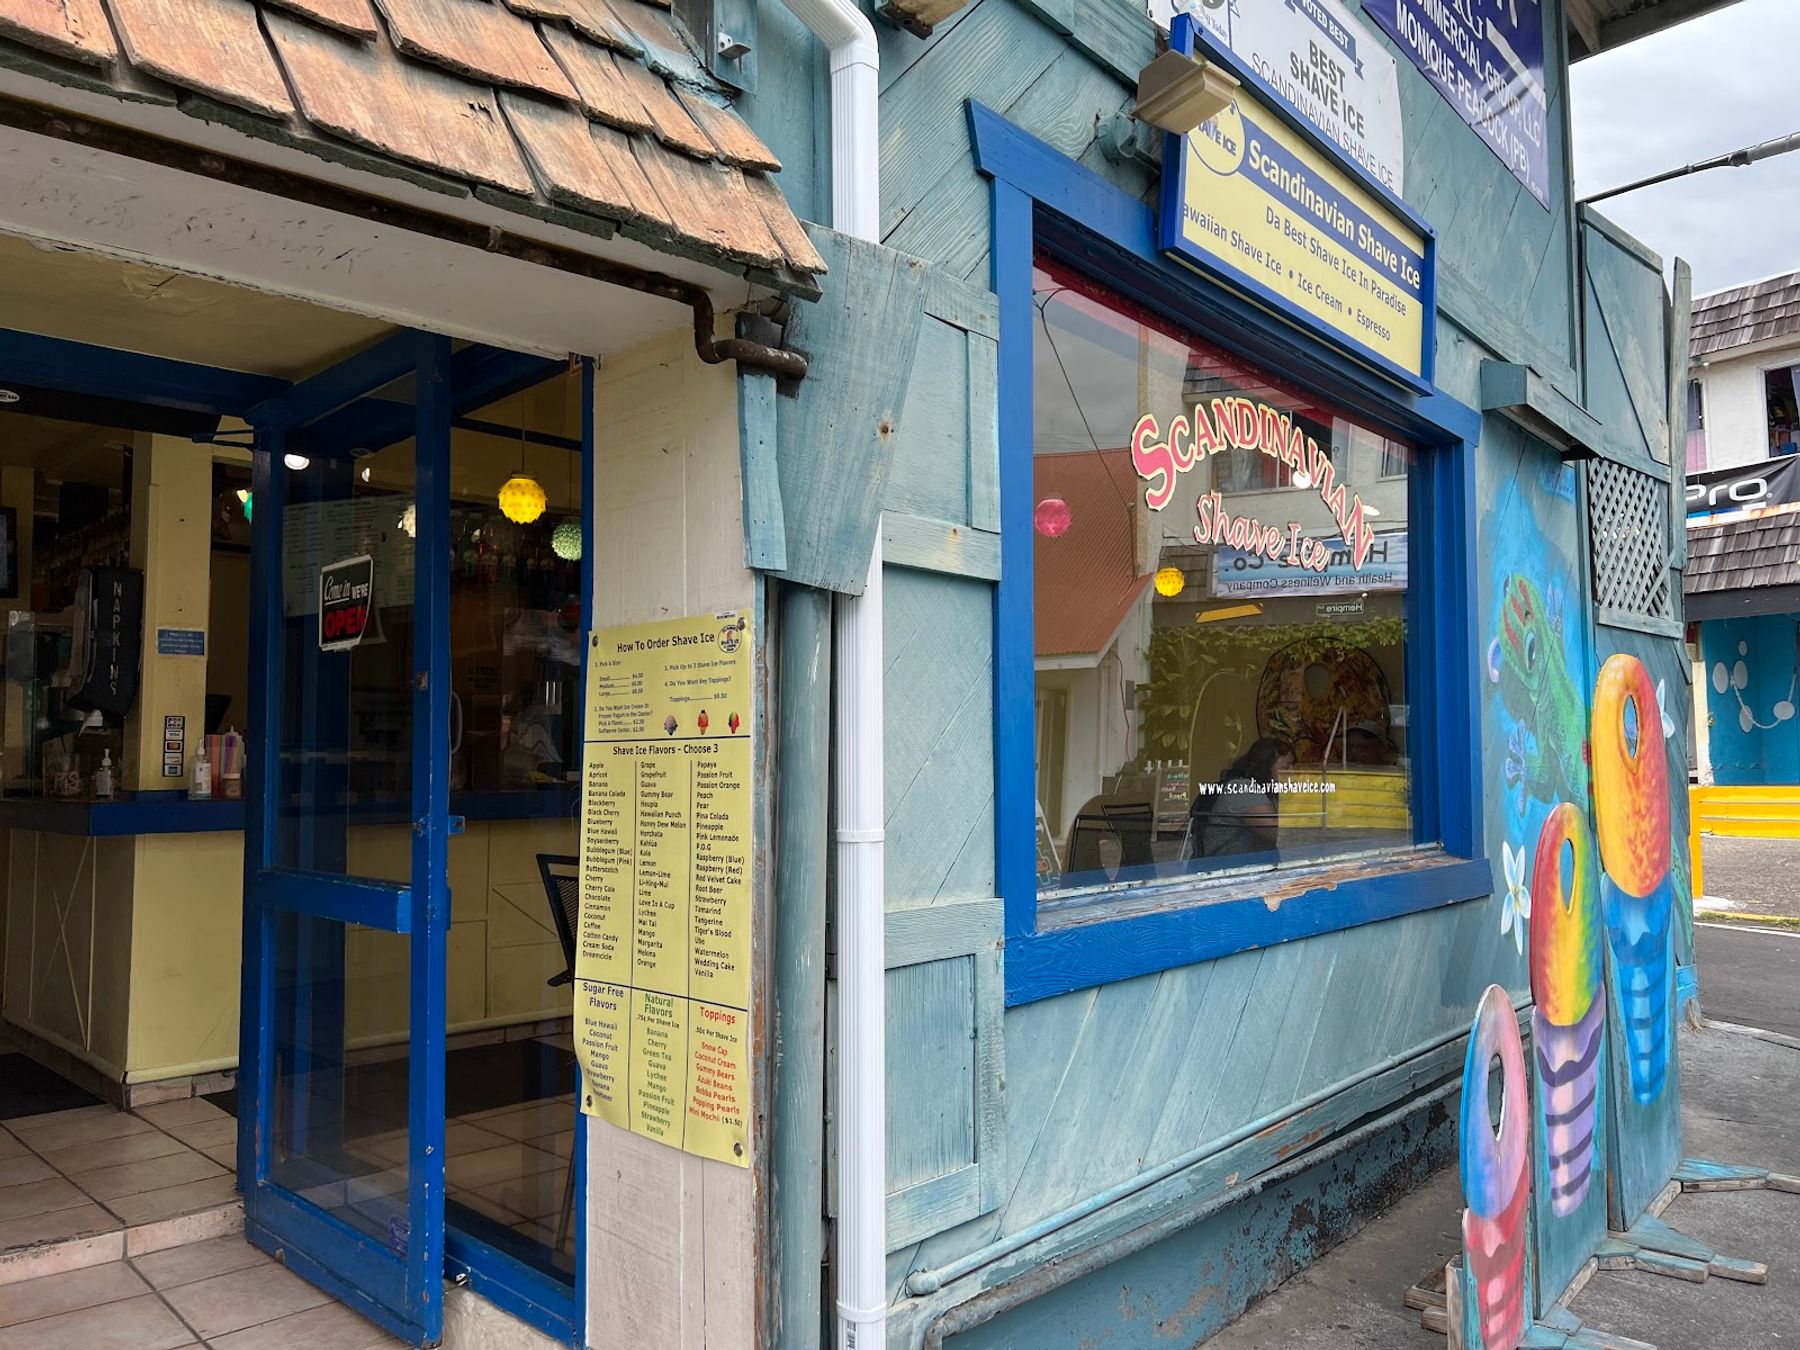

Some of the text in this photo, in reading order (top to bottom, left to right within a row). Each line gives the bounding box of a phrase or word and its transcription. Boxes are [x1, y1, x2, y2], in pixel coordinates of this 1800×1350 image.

[1301, 0, 1349, 49] VOTED BEST
[1309, 40, 1346, 92] BEST
[1417, 0, 1485, 81] MMERCIAL
[1522, 106, 1540, 147] LLC
[1290, 52, 1365, 138] SHAVE ICE
[1396, 1, 1455, 92] MONIQUE
[1457, 69, 1509, 154] PEACOCK
[1510, 135, 1530, 182] (PB)
[1252, 53, 1394, 191] SCANDINAVIAN SHAVE ICE
[1199, 120, 1236, 156] AVE ICE
[1248, 139, 1420, 290] Scandinavian Shave Ice
[1184, 204, 1282, 275] awaiian Shave Ice
[1266, 206, 1406, 316] Da Best Shave Ice In Paradise
[1298, 272, 1342, 312] Ice Cream
[1357, 308, 1390, 340] Espresso
[1131, 396, 1374, 571] SCANDINAVIAN
[1193, 490, 1286, 560] Shave
[1288, 522, 1330, 572] Ice
[324, 576, 369, 600] Come in WE'RE
[324, 605, 367, 639] OPEN
[110, 580, 123, 697] NAPKINS
[617, 643, 633, 653] How
[635, 641, 644, 651] To
[646, 638, 669, 650] Order
[672, 634, 698, 646] Shave
[700, 633, 714, 643] Ice
[613, 746, 633, 756] Shave
[636, 746, 646, 755] Ice
[649, 745, 676, 755] Flavors
[684, 744, 711, 754] Choose
[714, 744, 718, 752] 3
[1199, 778, 1336, 795] www.scandinavianshaveice.com
[587, 847, 615, 855] Bubblegum
[586, 856, 615, 864] Bubblegum
[696, 854, 744, 864] Raspberry (Blue)
[639, 870, 670, 878] Lemon-Lime
[696, 864, 742, 875] Raspberry (Red)
[696, 885, 708, 893] Root
[696, 895, 726, 905] Strawberry
[584, 903, 611, 911] Cinnamon
[695, 906, 721, 914] Tamarind
[695, 916, 723, 925] Tangerine
[602, 934, 618, 942] Candy
[638, 929, 655, 937] Mango
[695, 927, 732, 937] Tiger's Blood
[638, 939, 663, 948] Margarita
[695, 948, 729, 959] Watermelon
[637, 959, 656, 968] Orange
[695, 958, 734, 970] Wedding Cake
[695, 969, 713, 978] Vanilla
[583, 983, 624, 997] Sugar Free
[590, 997, 617, 1010] Flavors
[645, 994, 673, 1007] Natural
[645, 1004, 672, 1018] Flavors
[700, 1007, 736, 1024] Toppings
[585, 1018, 617, 1030] Blue Hawaii
[589, 1029, 612, 1040] Coconut
[583, 1038, 618, 1051] Passion Fruit
[702, 1042, 727, 1056] Snow Cap
[591, 1050, 609, 1060] Mango
[643, 1048, 671, 1060] Green Tea
[695, 1052, 736, 1069] Coconut Cream
[647, 1071, 667, 1081] Lychee
[696, 1064, 734, 1080] Gummy Bears
[693, 1096, 740, 1114] Popping Pearls
